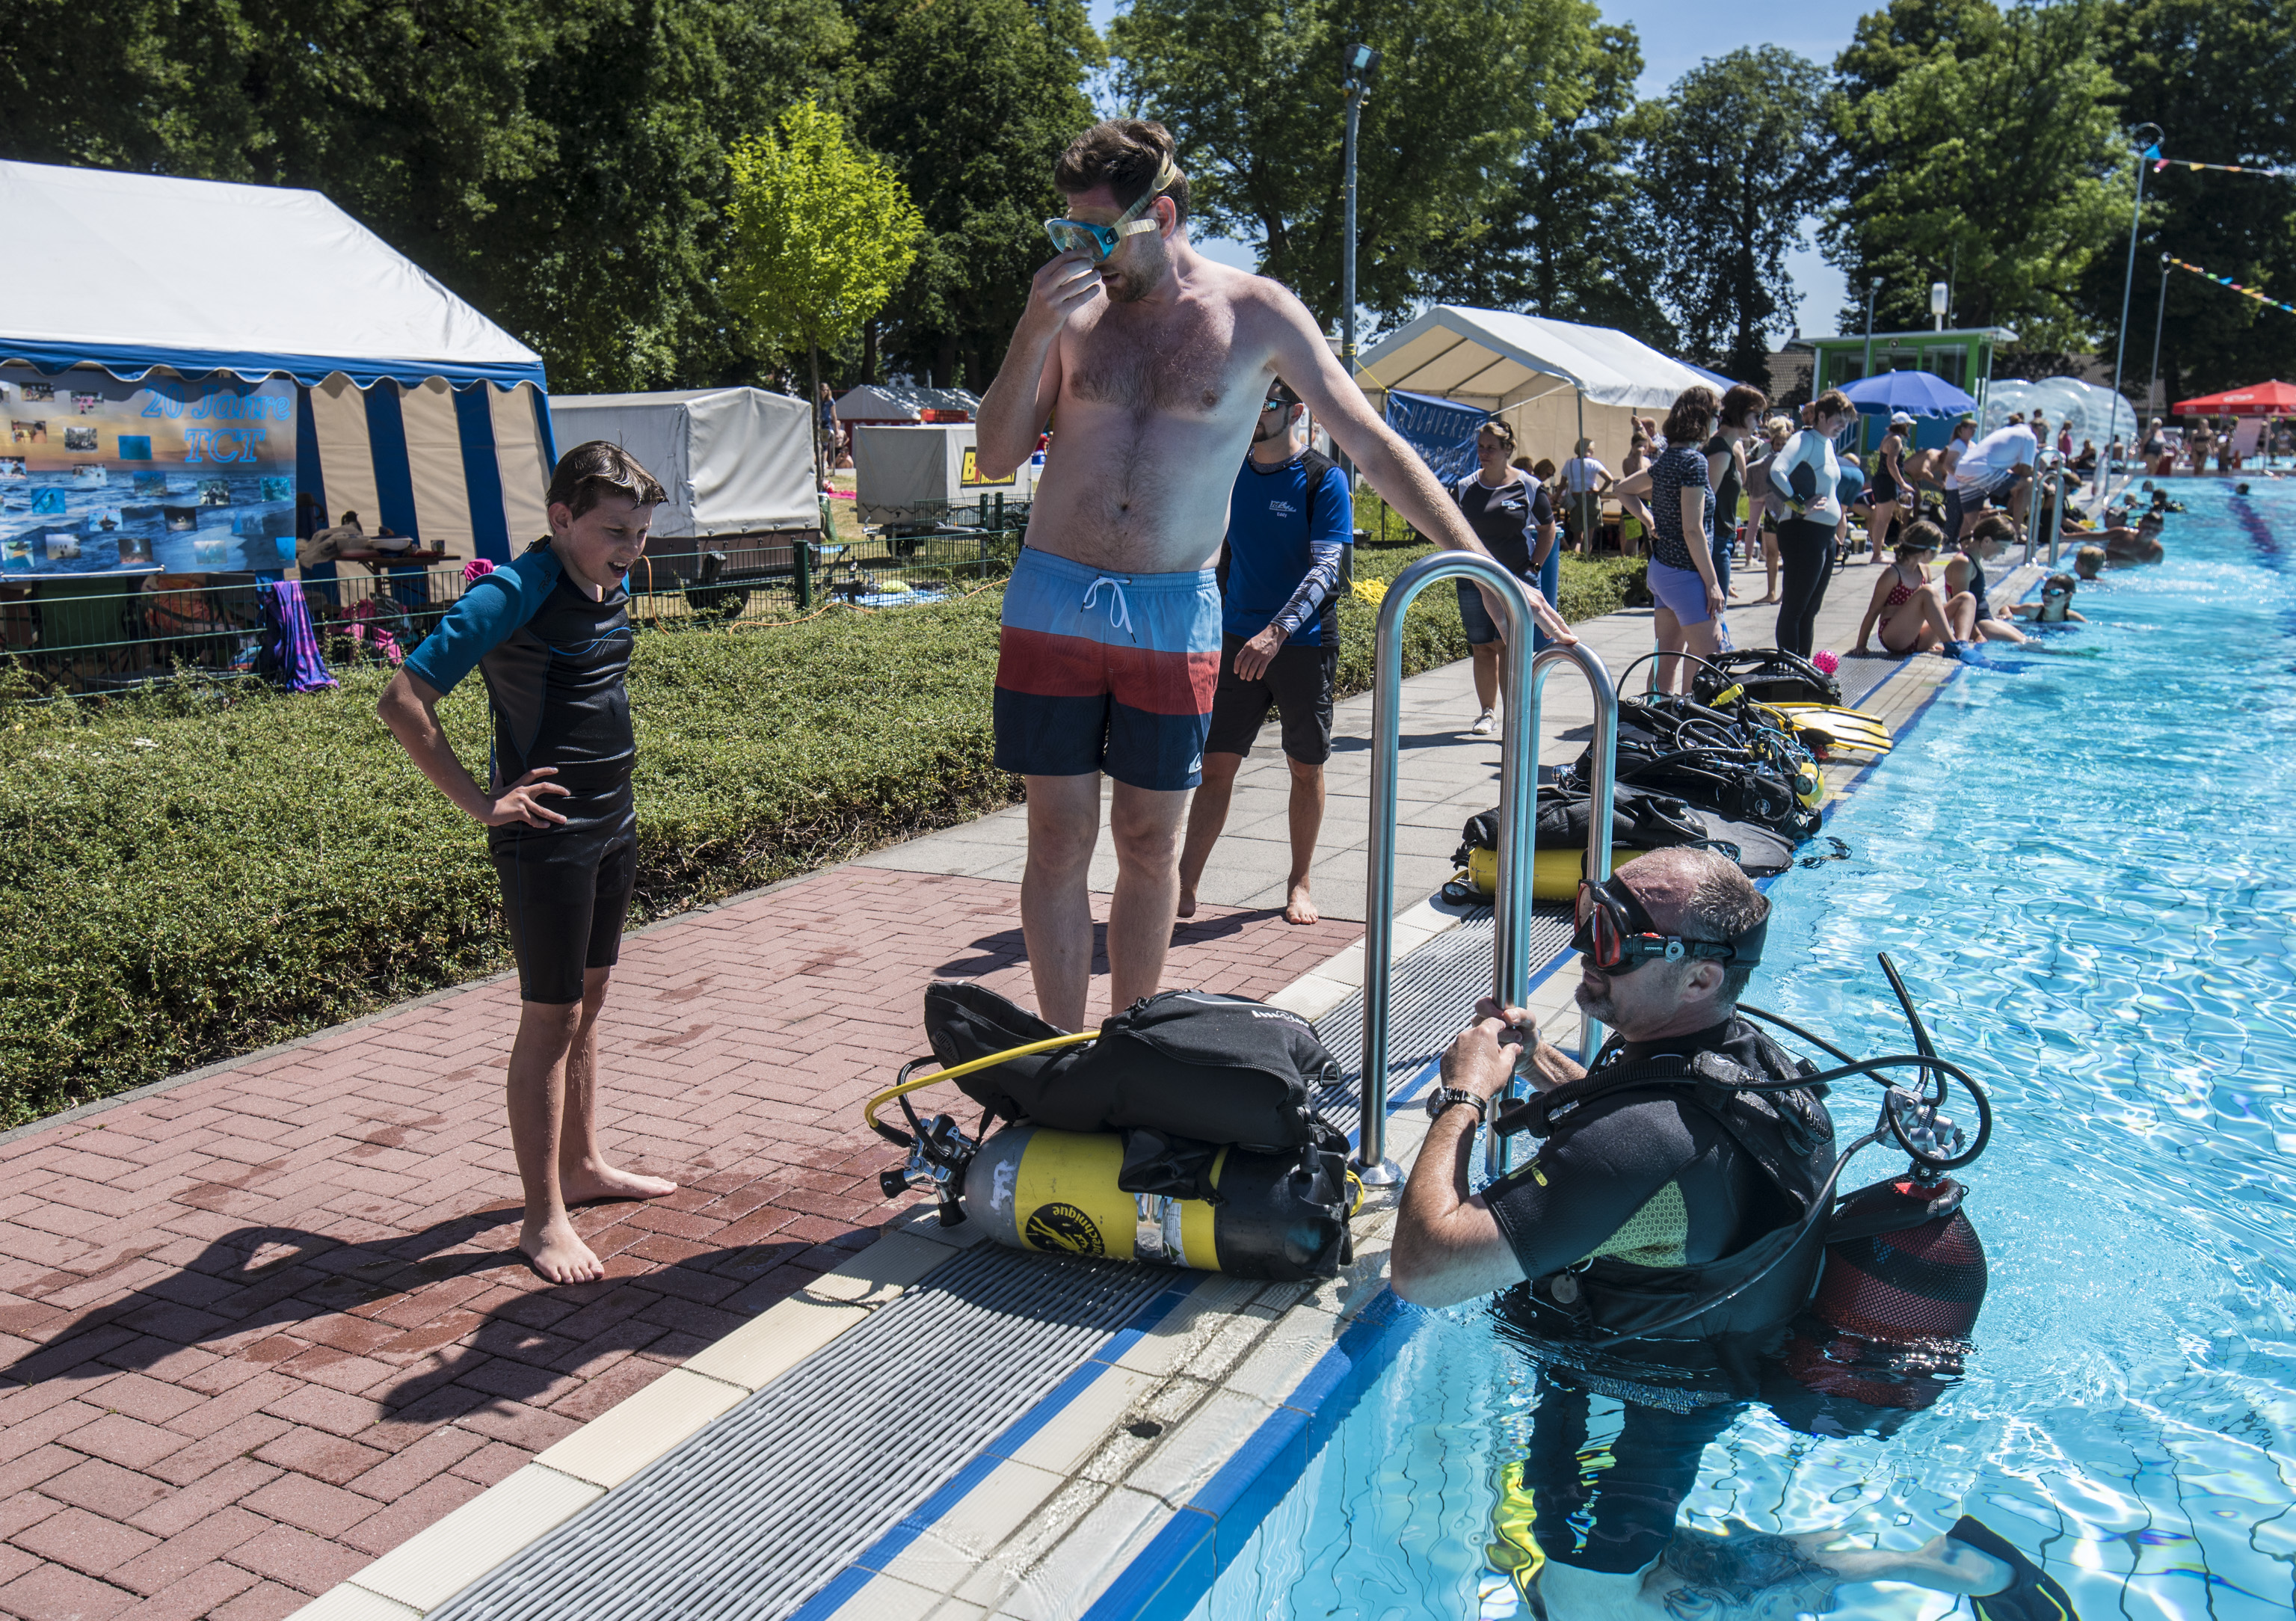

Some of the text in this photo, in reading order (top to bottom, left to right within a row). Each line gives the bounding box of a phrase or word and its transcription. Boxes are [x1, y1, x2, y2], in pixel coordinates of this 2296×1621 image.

[141, 383, 291, 420] 20 Jahre
[185, 428, 266, 463] TCT
